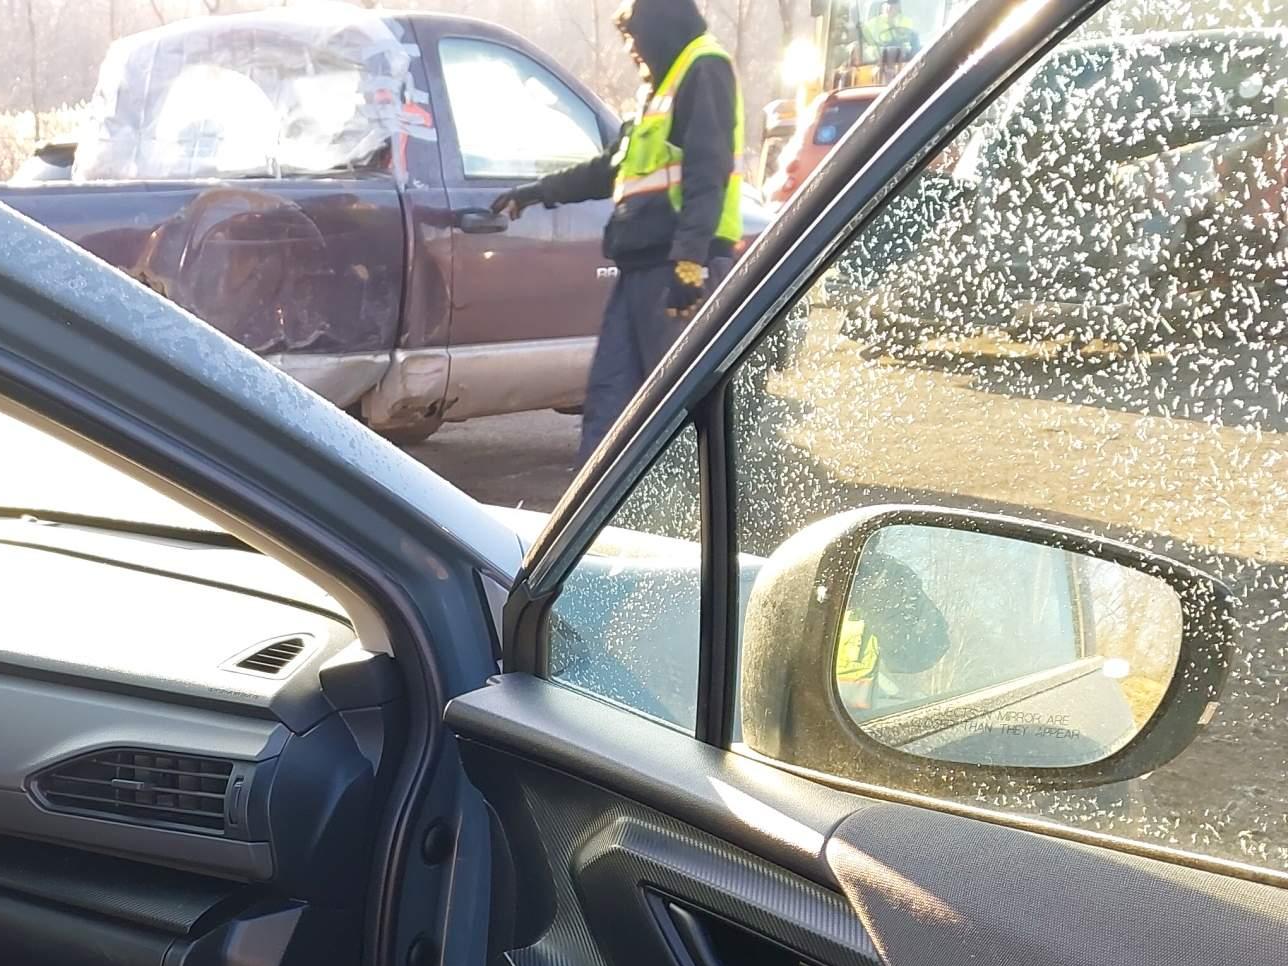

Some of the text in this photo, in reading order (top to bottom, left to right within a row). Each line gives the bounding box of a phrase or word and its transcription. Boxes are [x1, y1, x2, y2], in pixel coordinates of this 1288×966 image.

[998, 710, 1041, 724] MIRROR
[1046, 713, 1071, 726] ARE
[964, 721, 993, 733] THAN
[999, 723, 1029, 737] THEY
[1035, 726, 1081, 740] APPEAR
